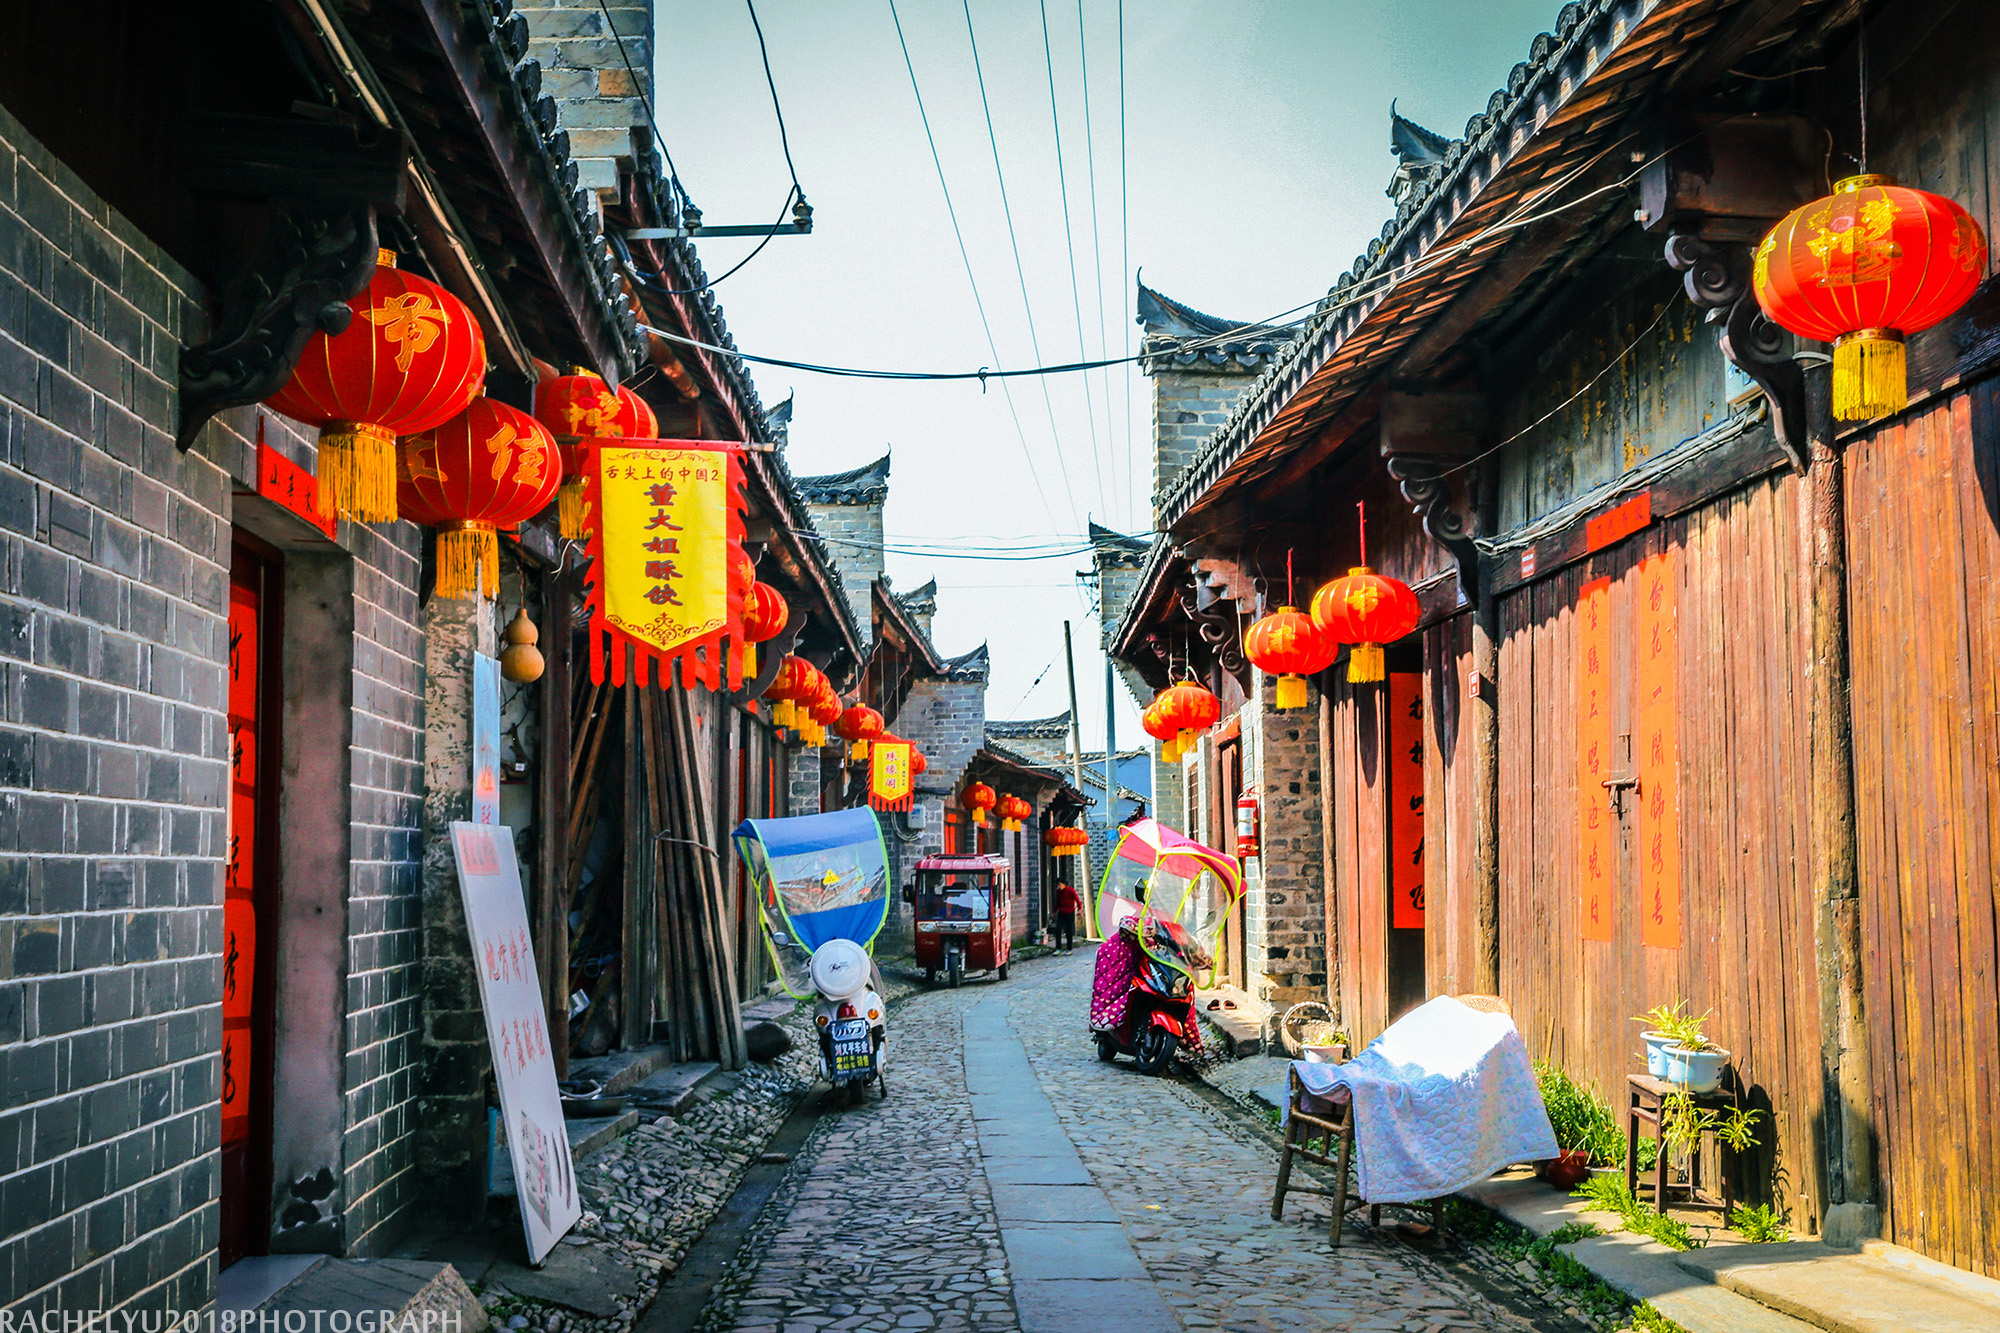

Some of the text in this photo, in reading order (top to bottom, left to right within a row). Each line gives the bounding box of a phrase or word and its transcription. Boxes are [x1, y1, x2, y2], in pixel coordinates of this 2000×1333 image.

[604, 465, 719, 483] 舌尖上的中国2
[641, 482, 684, 607] 董大姐酥饺
